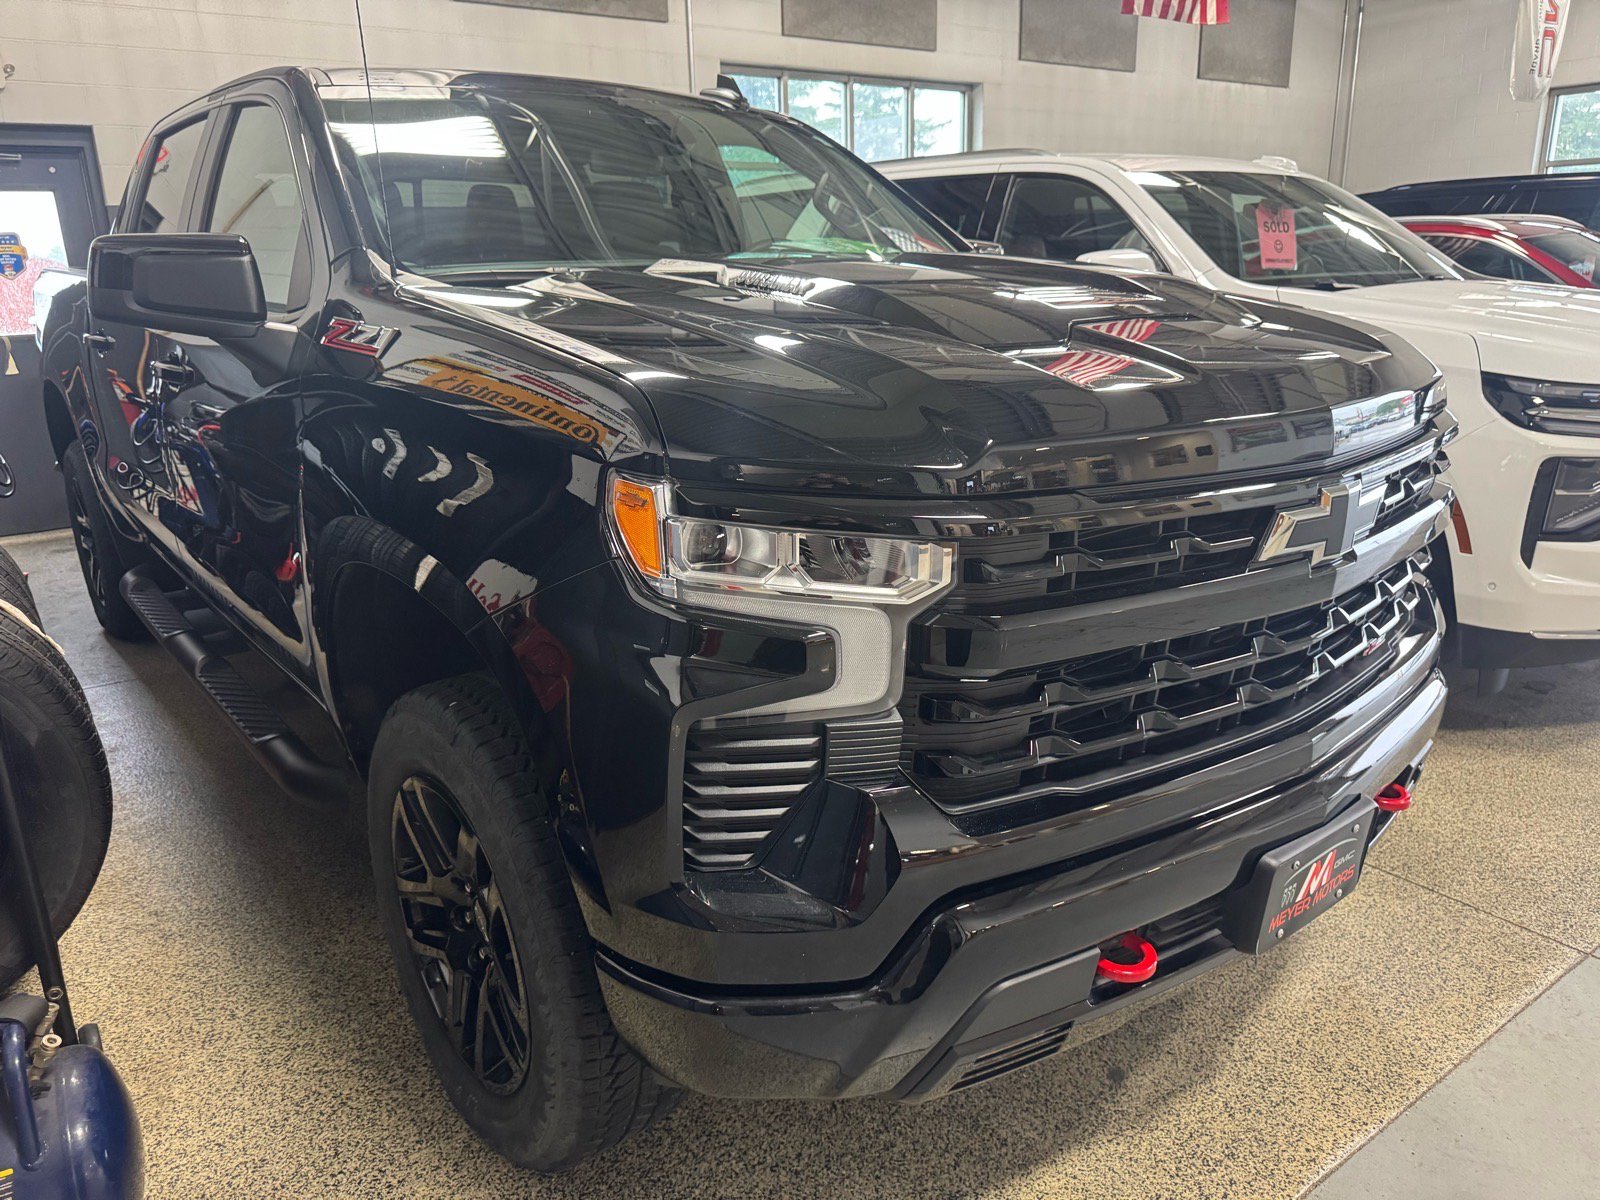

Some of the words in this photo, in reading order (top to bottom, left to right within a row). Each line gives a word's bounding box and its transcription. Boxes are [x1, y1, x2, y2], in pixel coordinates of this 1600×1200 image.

[1262, 221, 1290, 233] SOLD
[320, 316, 401, 359] Z71
[1333, 849, 1356, 869] GMC
[1268, 896, 1312, 934] MEYER
[1312, 863, 1356, 906] MOTORS
